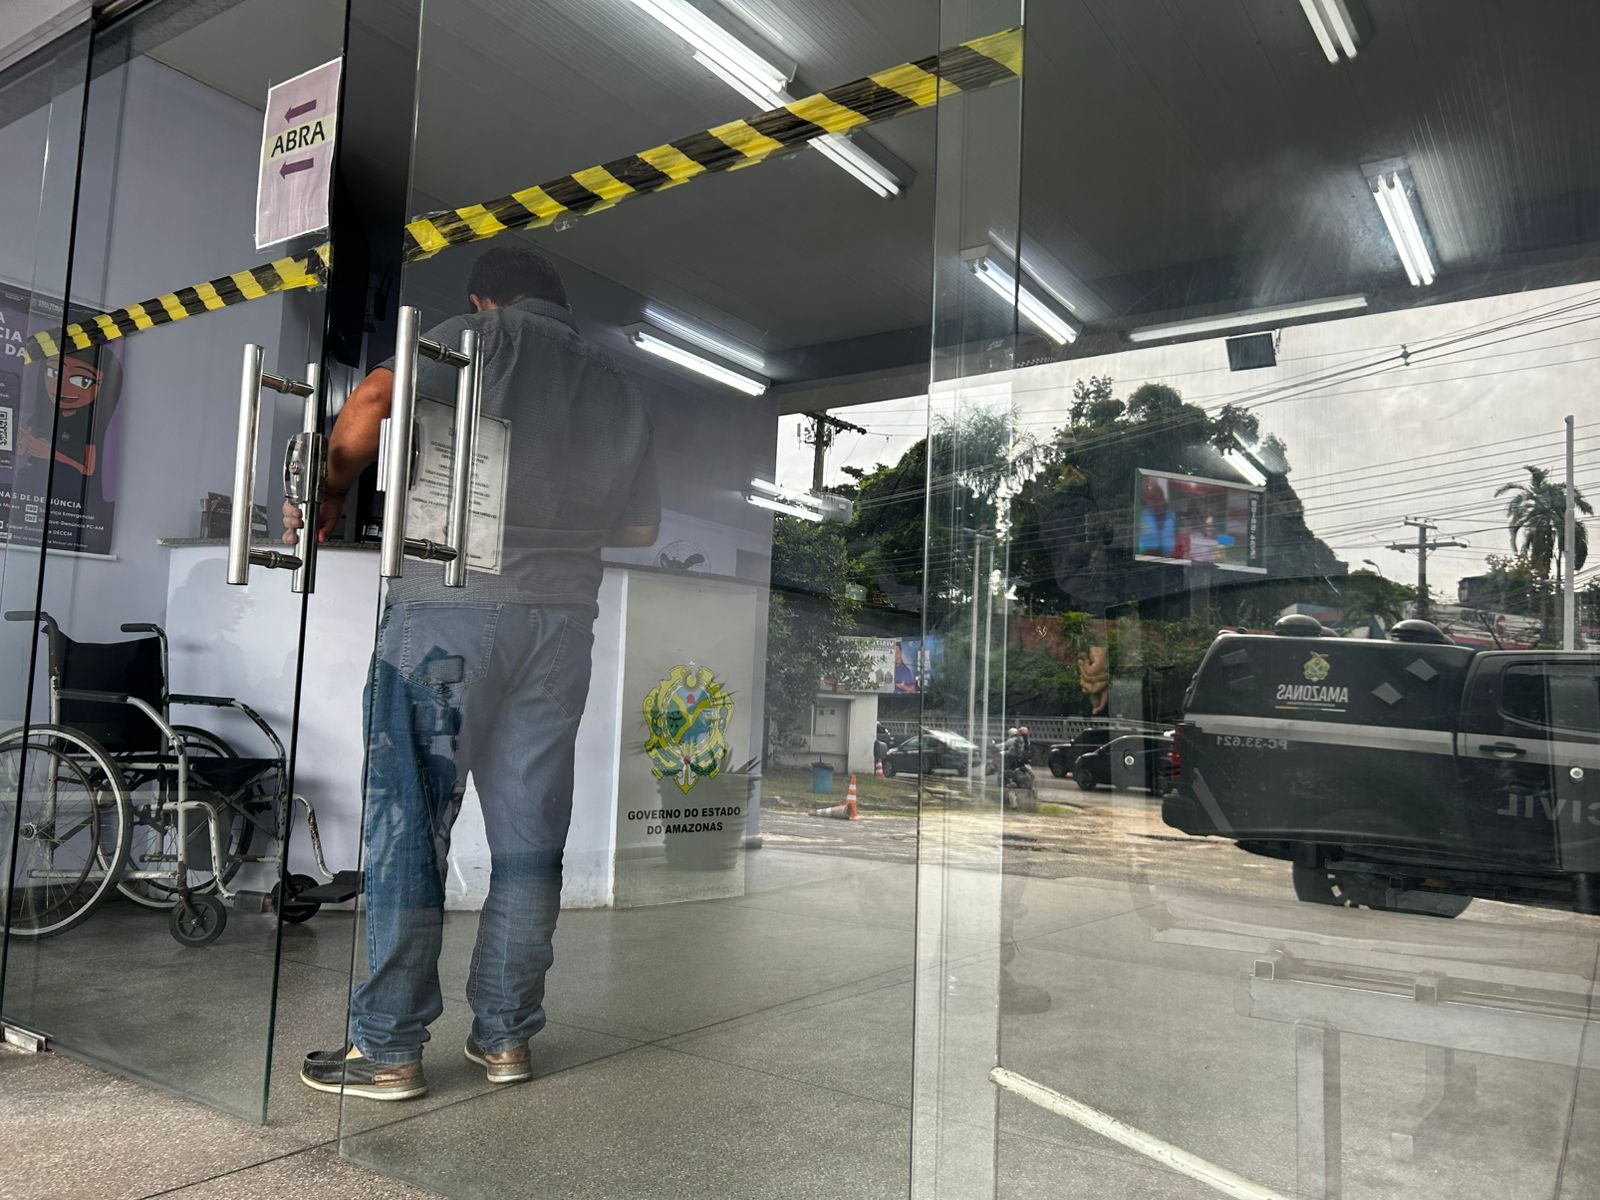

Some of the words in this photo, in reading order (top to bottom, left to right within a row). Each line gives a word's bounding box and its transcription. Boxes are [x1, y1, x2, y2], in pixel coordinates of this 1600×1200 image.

[270, 121, 325, 158] ABRA
[20, 493, 31, 501] DE
[627, 808, 681, 821] GOVERNO
[684, 808, 699, 818] DO
[701, 806, 741, 817] ESTADO
[647, 825, 662, 835] DO
[665, 822, 723, 834] AMAZONAS
